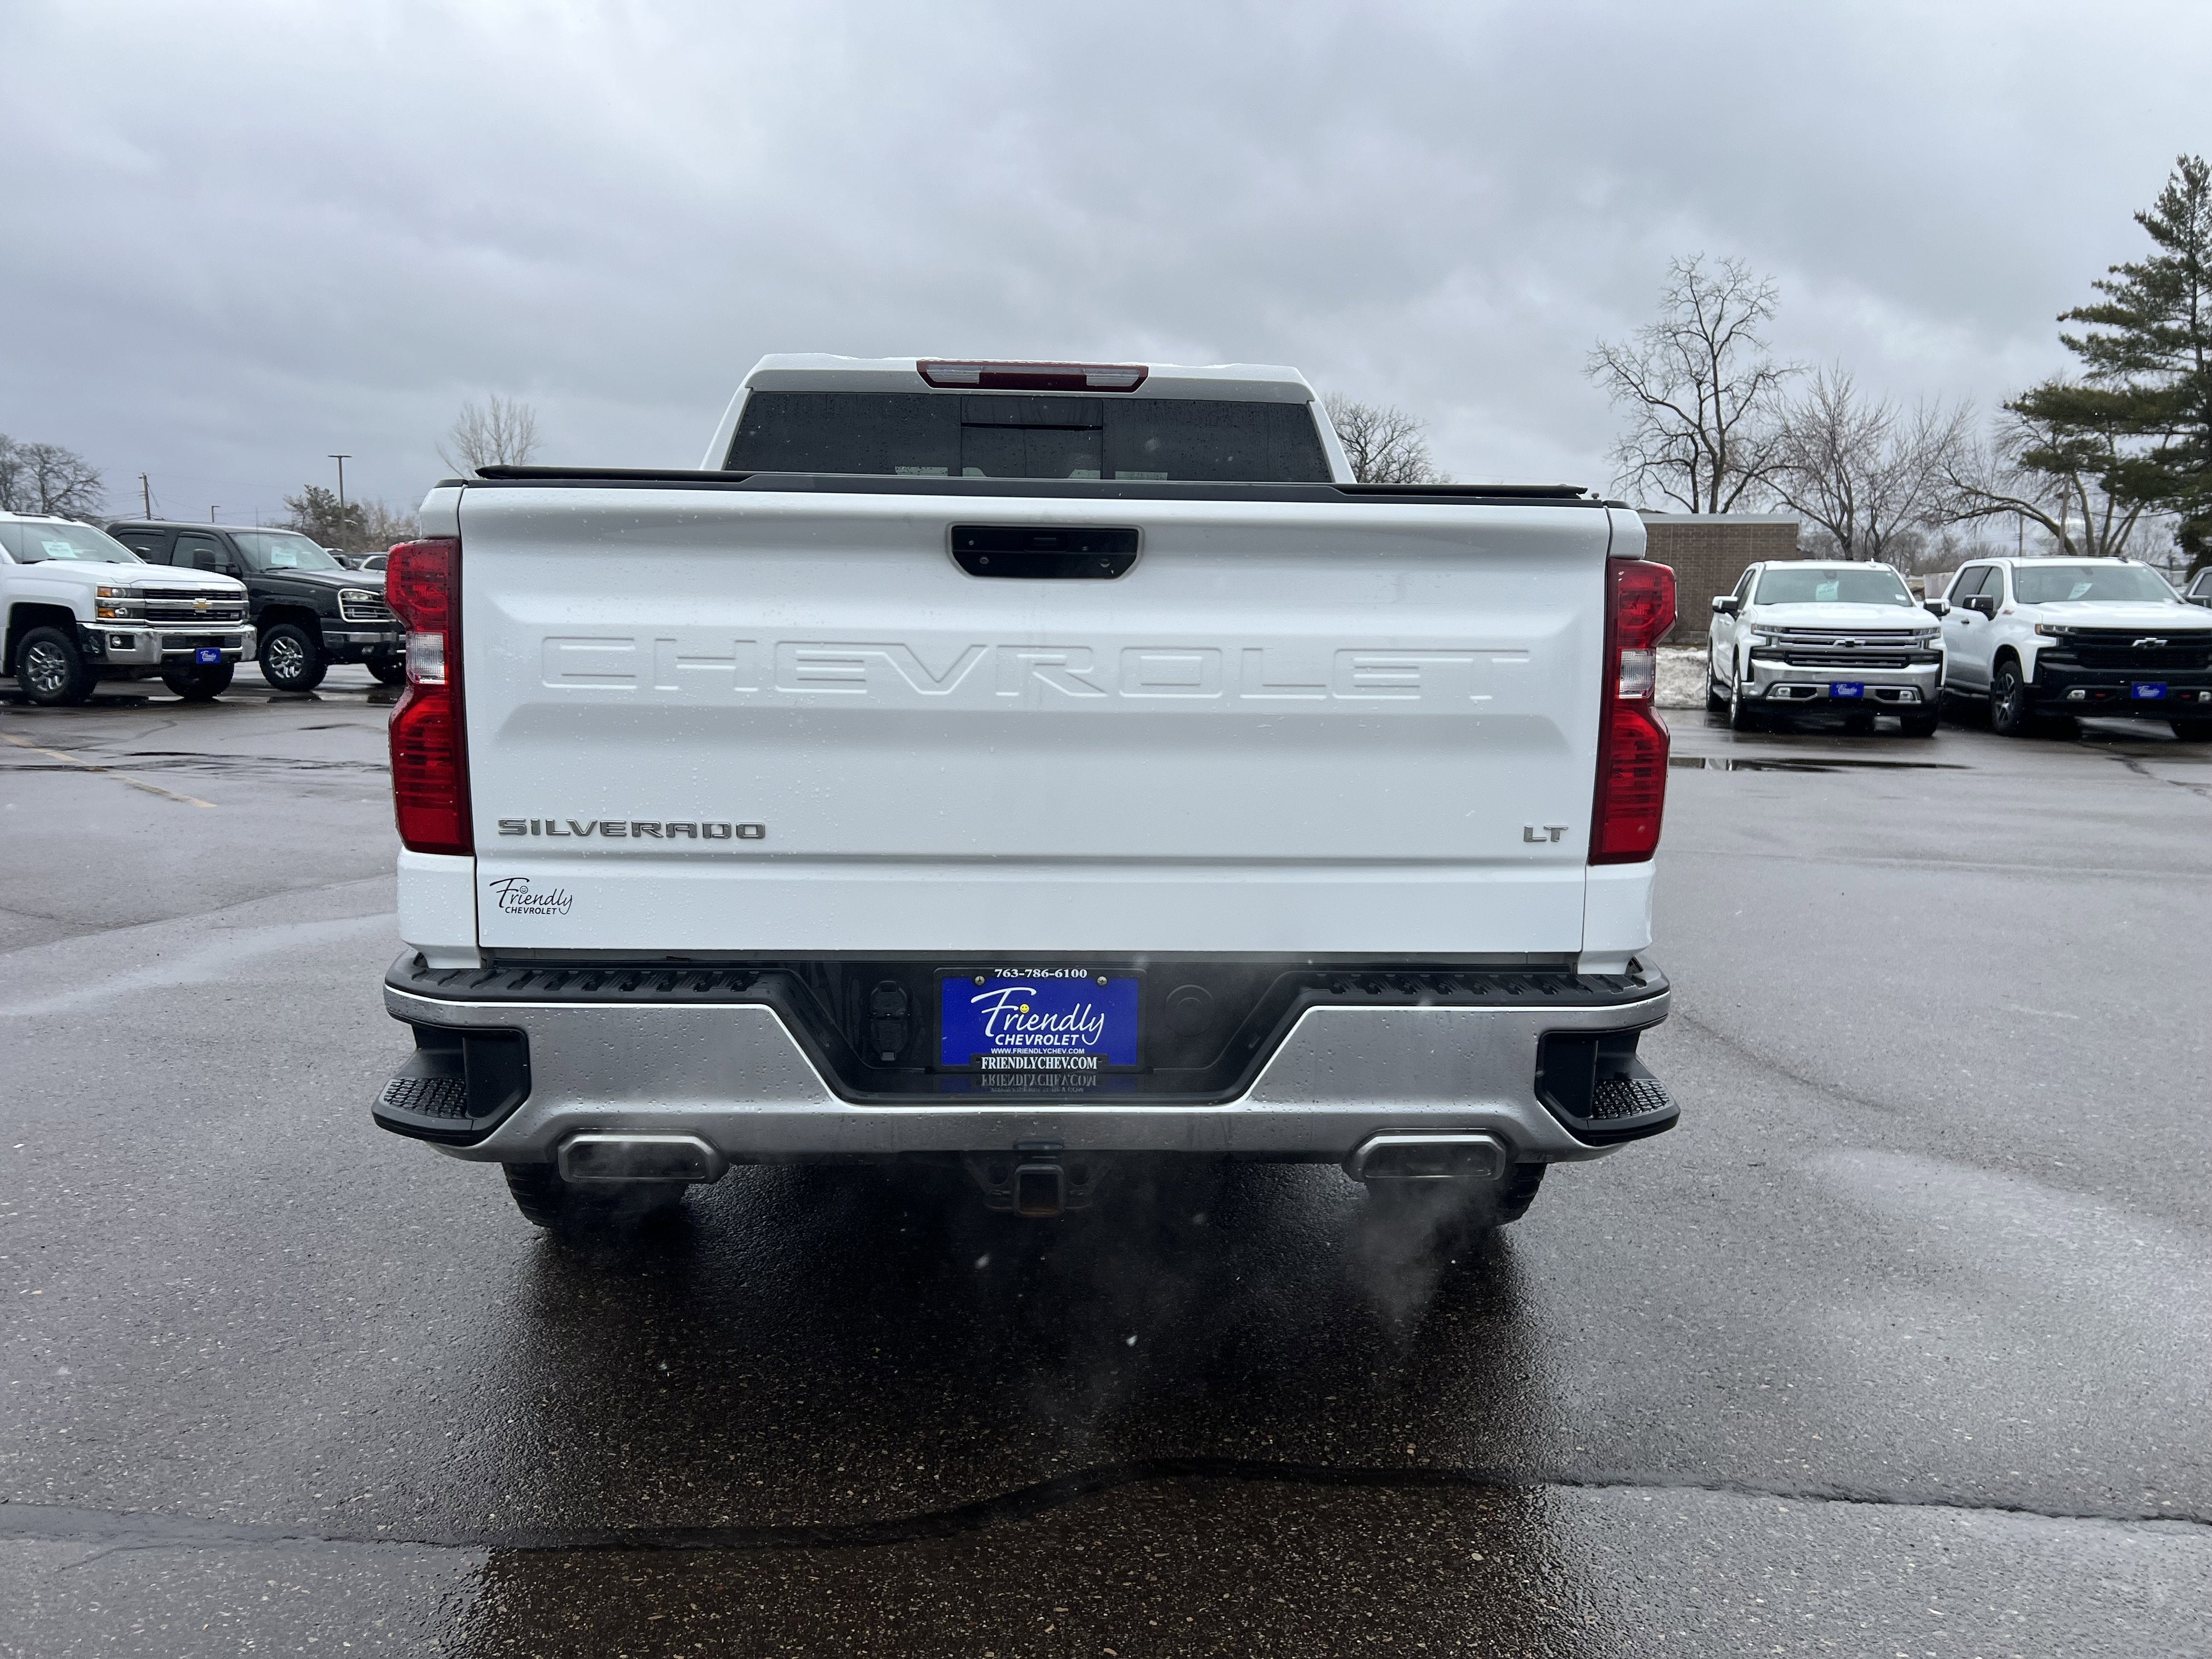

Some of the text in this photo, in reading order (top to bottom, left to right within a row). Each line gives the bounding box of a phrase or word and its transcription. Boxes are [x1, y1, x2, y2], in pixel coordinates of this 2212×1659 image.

[542, 636, 1531, 700] CHEVROLET
[498, 817, 766, 839] SILVERADO
[1523, 826, 1568, 842] LT
[489, 877, 573, 915] Friendly
[505, 906, 557, 915] CHEVROLET
[994, 969, 1087, 978] 763-786-6100
[970, 987, 1105, 1045] Friendly
[995, 1034, 1080, 1046] CHEVROLET
[980, 1056, 1097, 1070] FRIENDLYCHEV.COM
